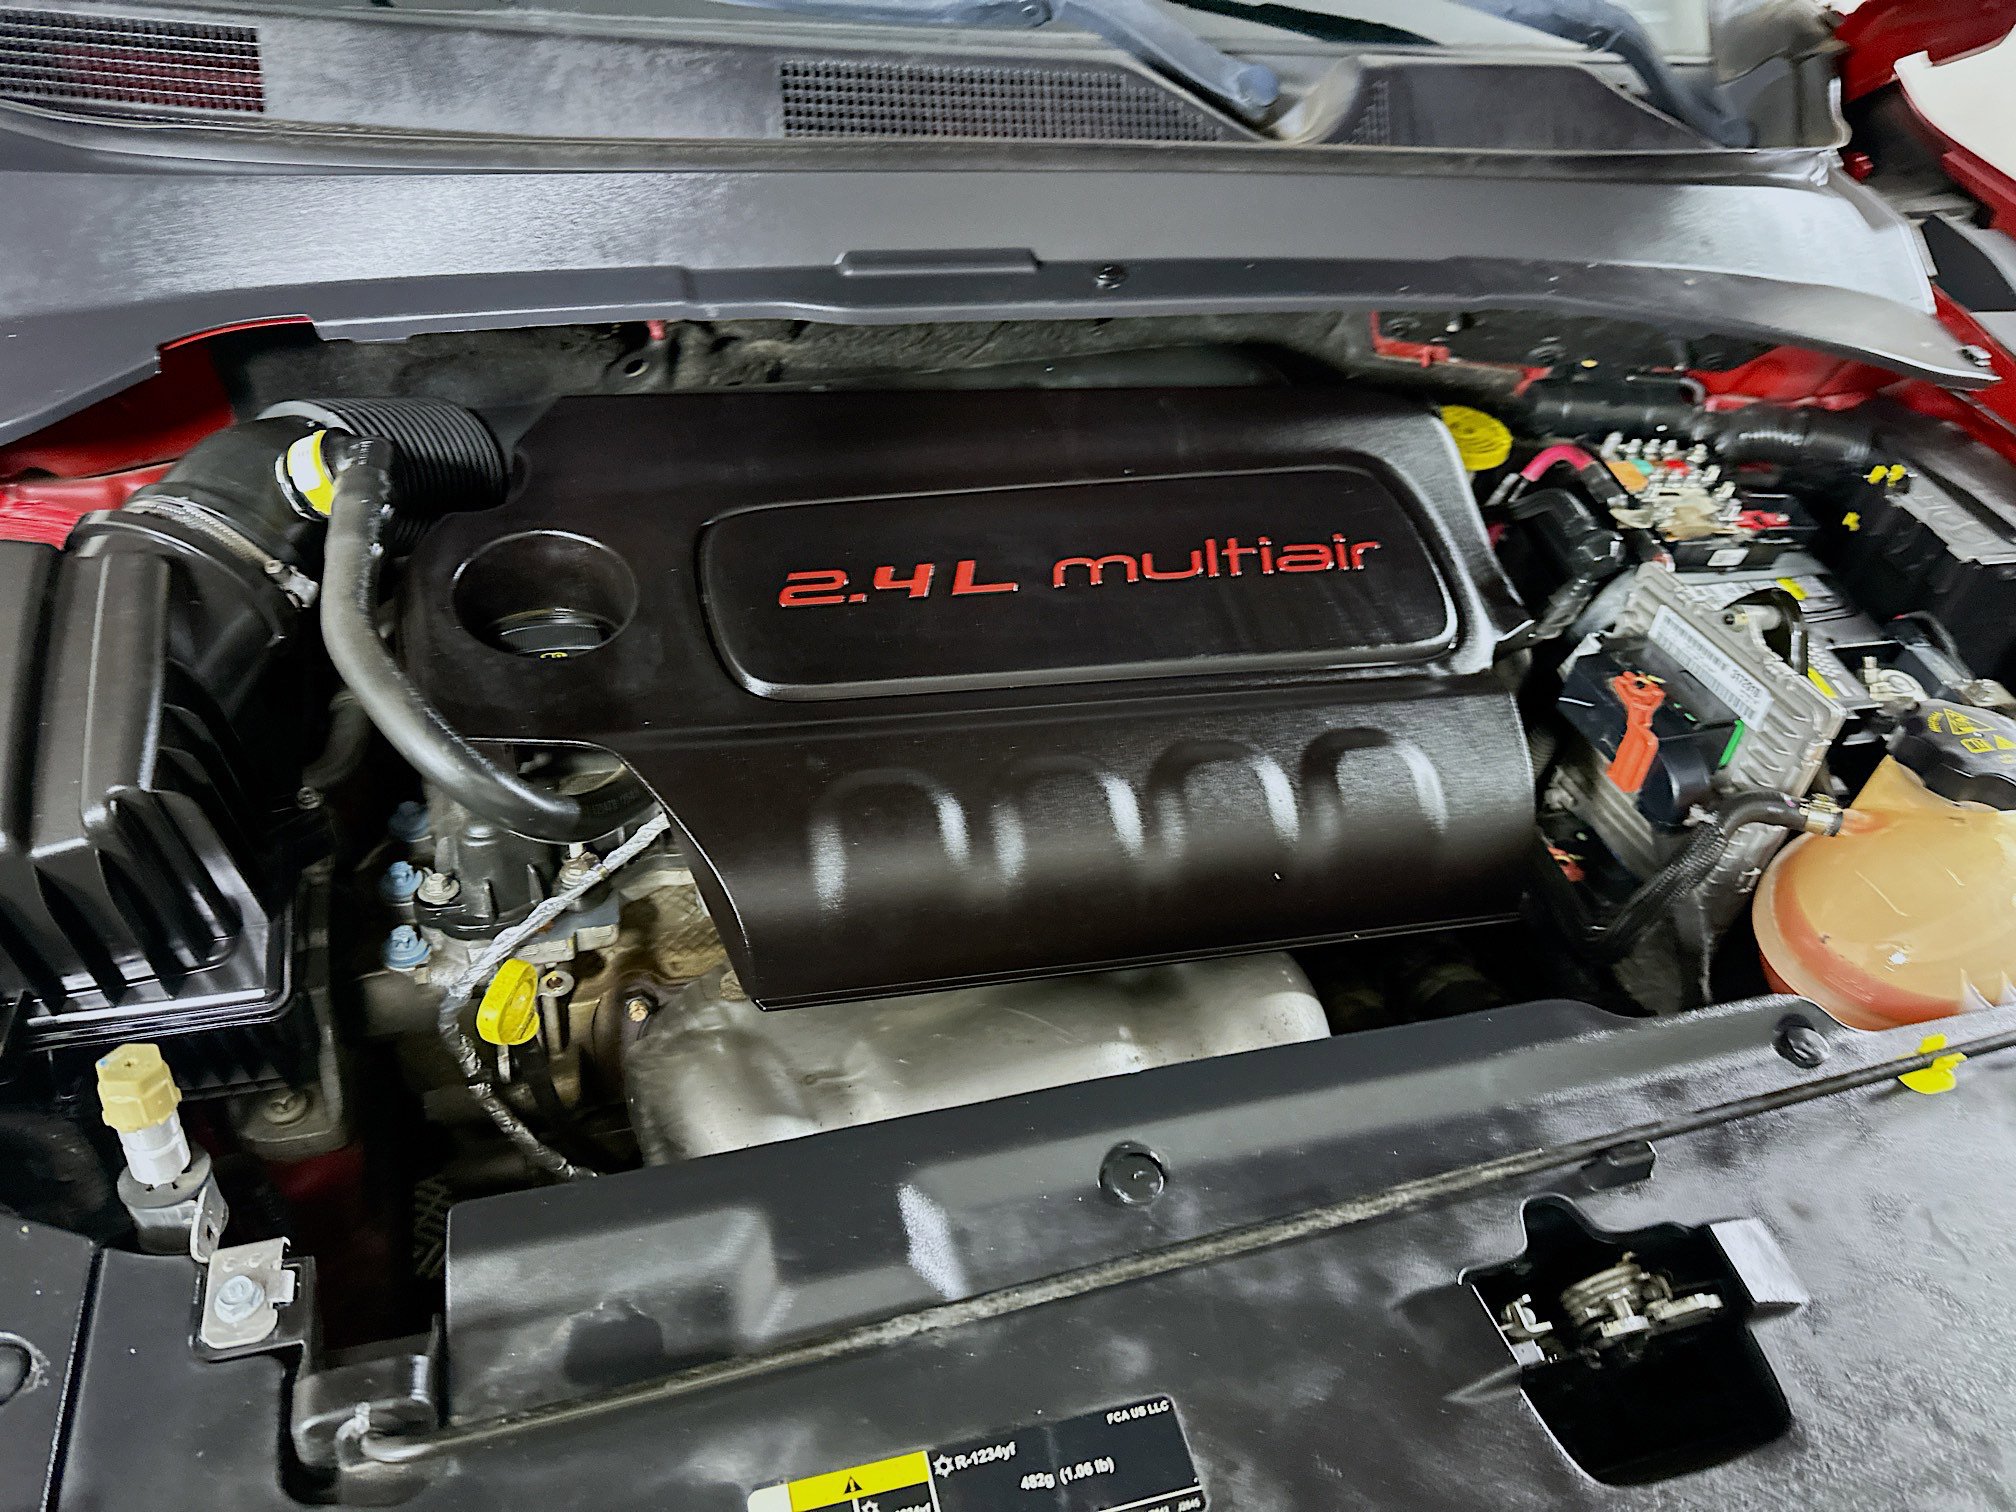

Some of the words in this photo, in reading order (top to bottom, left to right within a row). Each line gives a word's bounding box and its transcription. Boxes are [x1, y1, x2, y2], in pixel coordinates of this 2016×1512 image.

[1052, 532, 1382, 589] multiair
[1106, 1409, 1130, 1425] FCA
[1130, 1405, 1147, 1419] US
[1147, 1400, 1169, 1415] LLC
[954, 1441, 1017, 1470] R-1234yf
[1020, 1472, 1056, 1490] 482g
